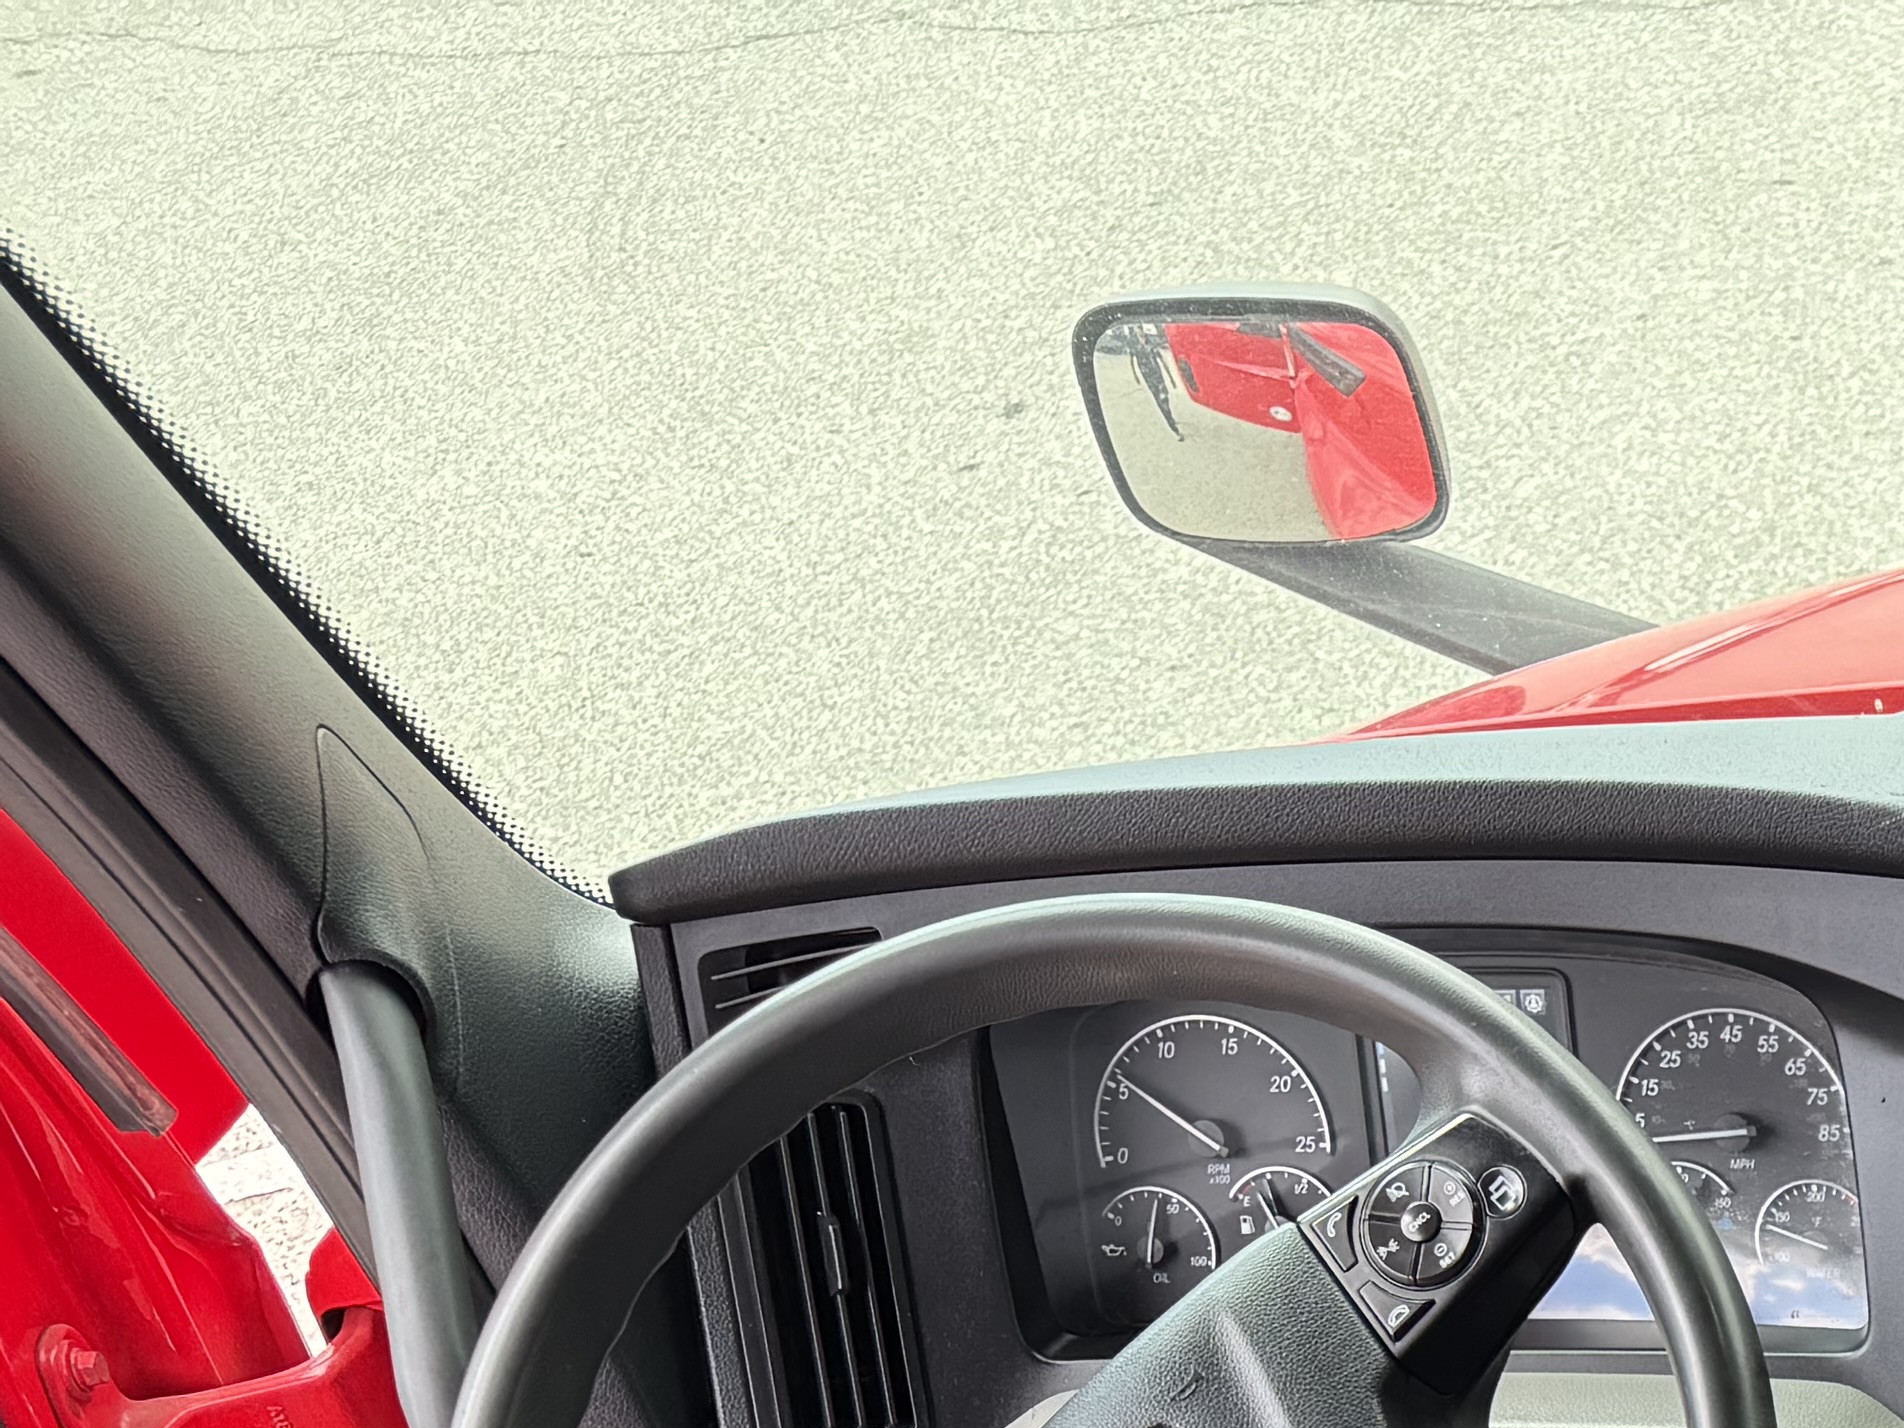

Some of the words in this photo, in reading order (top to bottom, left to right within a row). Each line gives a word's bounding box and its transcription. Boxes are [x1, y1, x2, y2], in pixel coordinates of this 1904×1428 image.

[1687, 1032, 1709, 1049] 35
[1720, 1025, 1742, 1043] 45
[1158, 1042, 1175, 1059] 10
[1221, 1038, 1238, 1055] 15
[1757, 1036, 1779, 1053] 55
[1660, 1051, 1681, 1068] 25
[1785, 1058, 1807, 1076] 65
[1118, 1083, 1128, 1100] 5
[1270, 1076, 1291, 1092] 20
[1641, 1079, 1659, 1096] 15
[1807, 1088, 1828, 1105] 75
[1819, 1124, 1841, 1142] 85
[1295, 1137, 1316, 1153] 25
[1118, 1148, 1128, 1164] 0
[1729, 1158, 1756, 1169] MPH
[1208, 1164, 1230, 1175] RPM
[1166, 1204, 1179, 1214] 50
[1244, 1196, 1251, 1206] E
[1115, 1217, 1122, 1226] 0
[1190, 1256, 1207, 1267] 100
